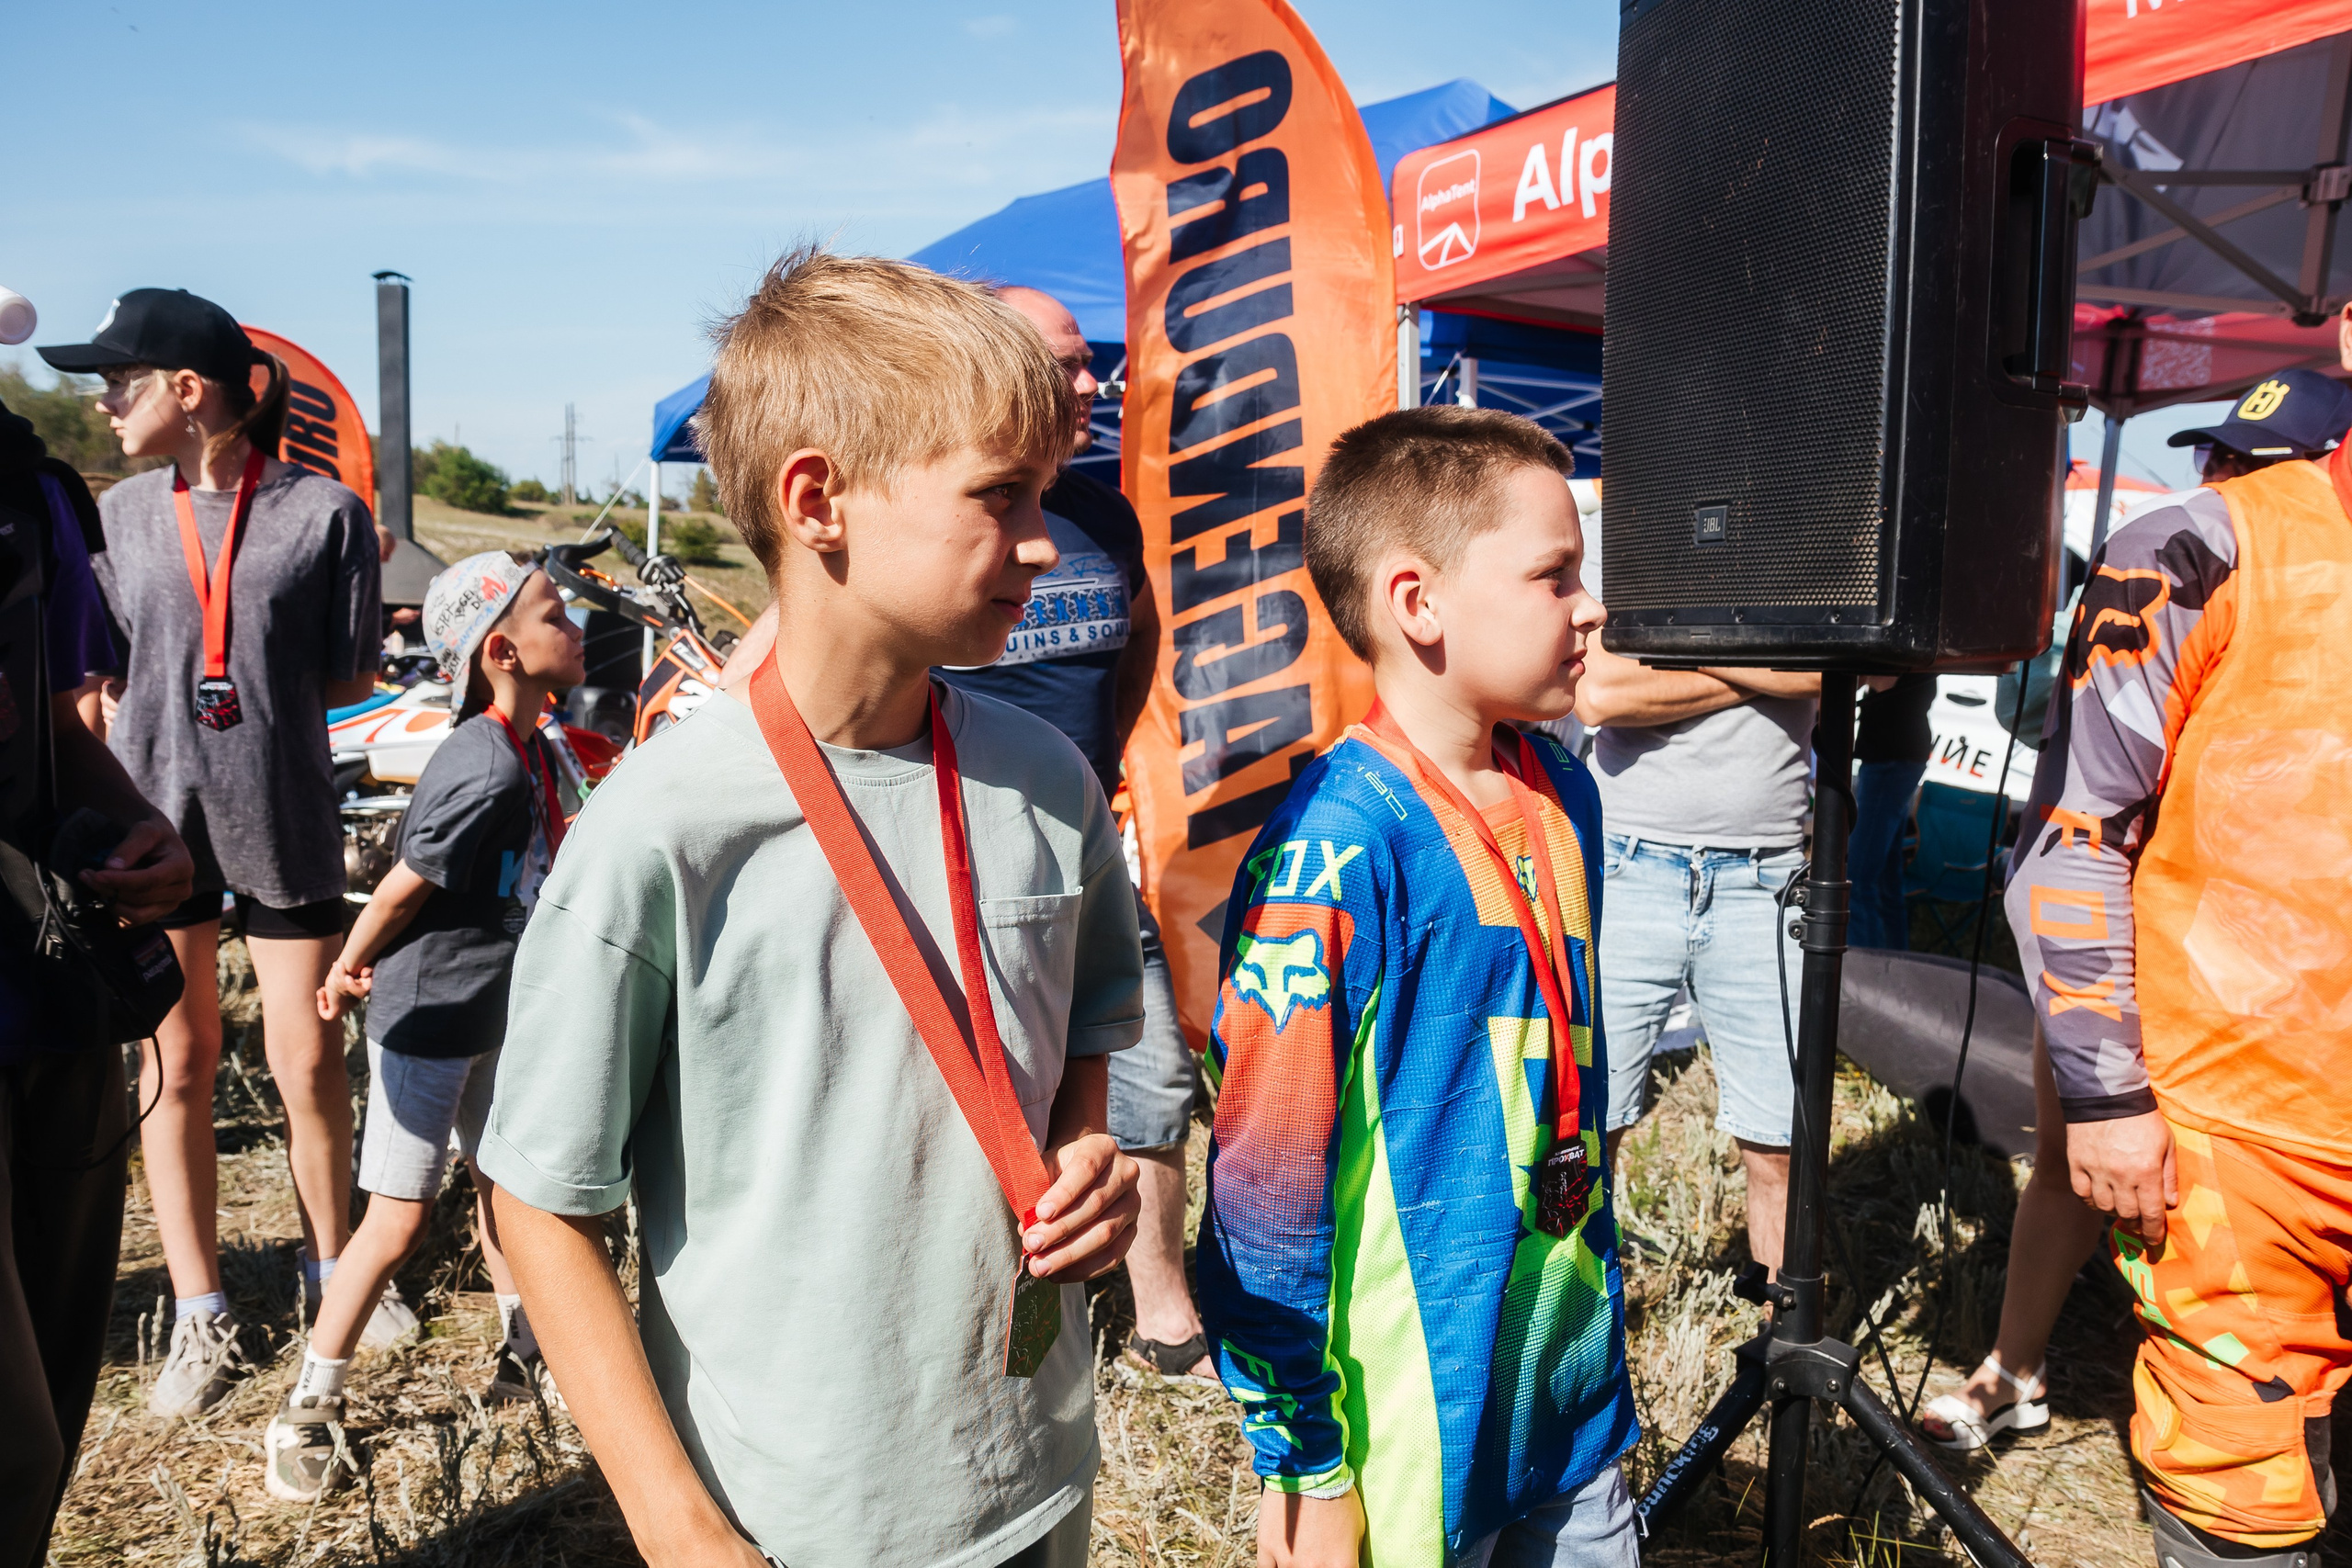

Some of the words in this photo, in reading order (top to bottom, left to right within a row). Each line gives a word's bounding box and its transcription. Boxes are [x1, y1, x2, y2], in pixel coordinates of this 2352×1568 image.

[1421, 178, 1476, 212] AlphaTent
[1512, 127, 1614, 222] Alp
[1703, 516, 1721, 533] JBL
[1247, 840, 1365, 905] FOX
[2030, 803, 2123, 1023] FOX
